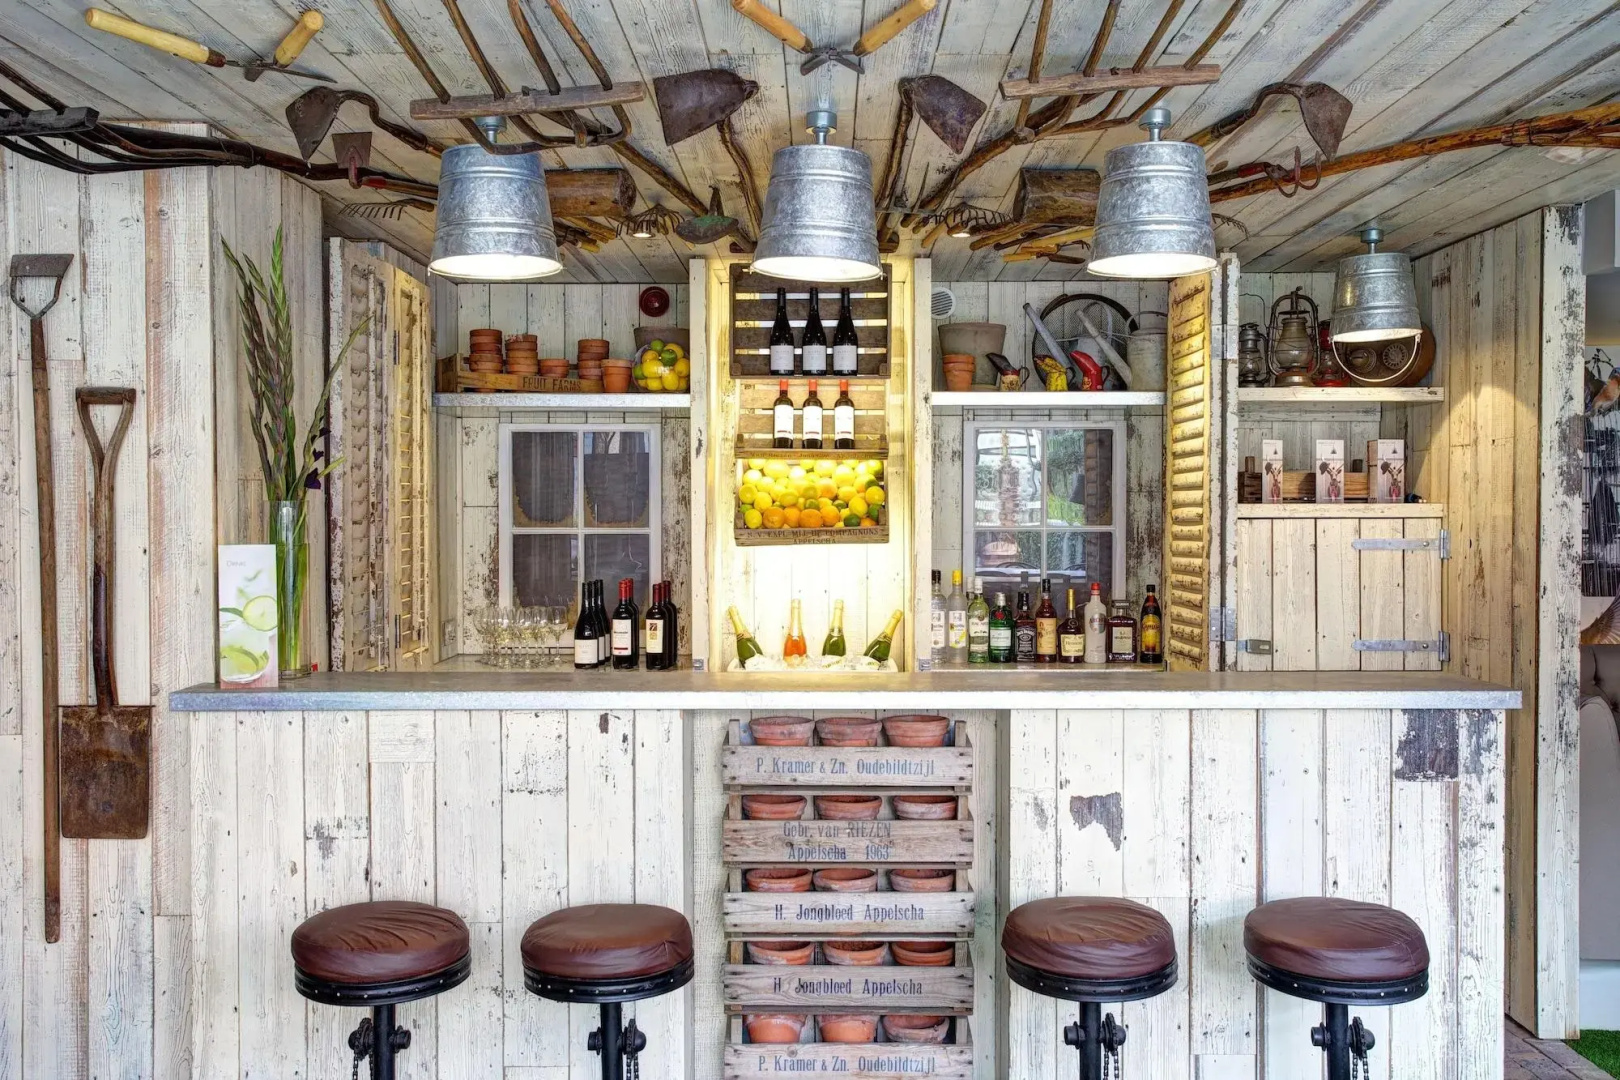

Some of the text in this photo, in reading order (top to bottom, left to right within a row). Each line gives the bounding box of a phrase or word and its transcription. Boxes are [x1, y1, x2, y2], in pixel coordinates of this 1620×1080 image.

[523, 376, 581, 391] FRUIT FARMS
[756, 757, 935, 778] P. Kramer & Zn. Oudebildtzijl
[783, 821, 891, 838] Gebr. van RIEZEN
[788, 844, 890, 861] Appelscha 1963
[775, 904, 924, 922] H. Jongbloed Appelscha
[795, 977, 852, 996] Jongbloed
[862, 978, 923, 996] Appelscha
[758, 1055, 936, 1075] P. Kramer & Zn. Oudebildtzijl
